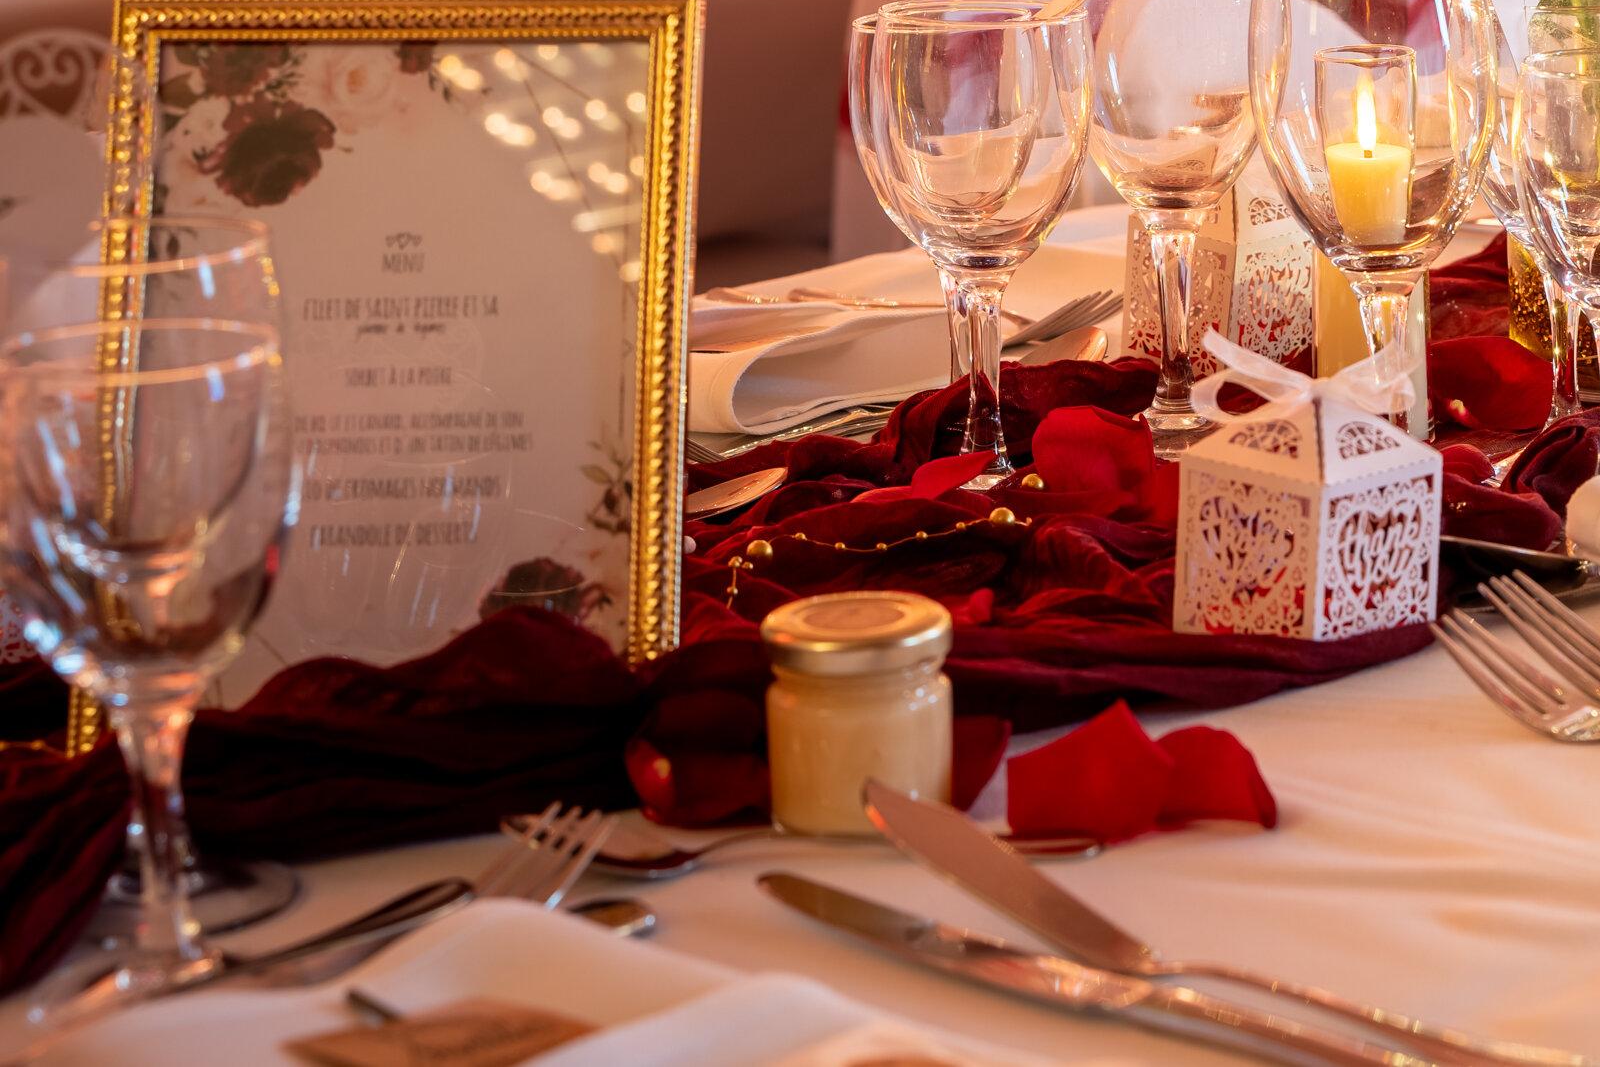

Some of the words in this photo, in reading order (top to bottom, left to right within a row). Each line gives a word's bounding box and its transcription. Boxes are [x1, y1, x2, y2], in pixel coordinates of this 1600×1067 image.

[382, 253, 425, 273] MENU
[304, 297, 341, 321] FILET
[345, 297, 360, 320] DE
[366, 296, 410, 319] SAINT
[414, 296, 459, 319] PIERRE
[463, 295, 478, 317] ET
[482, 295, 499, 317] SA
[1338, 504, 1421, 572] thank
